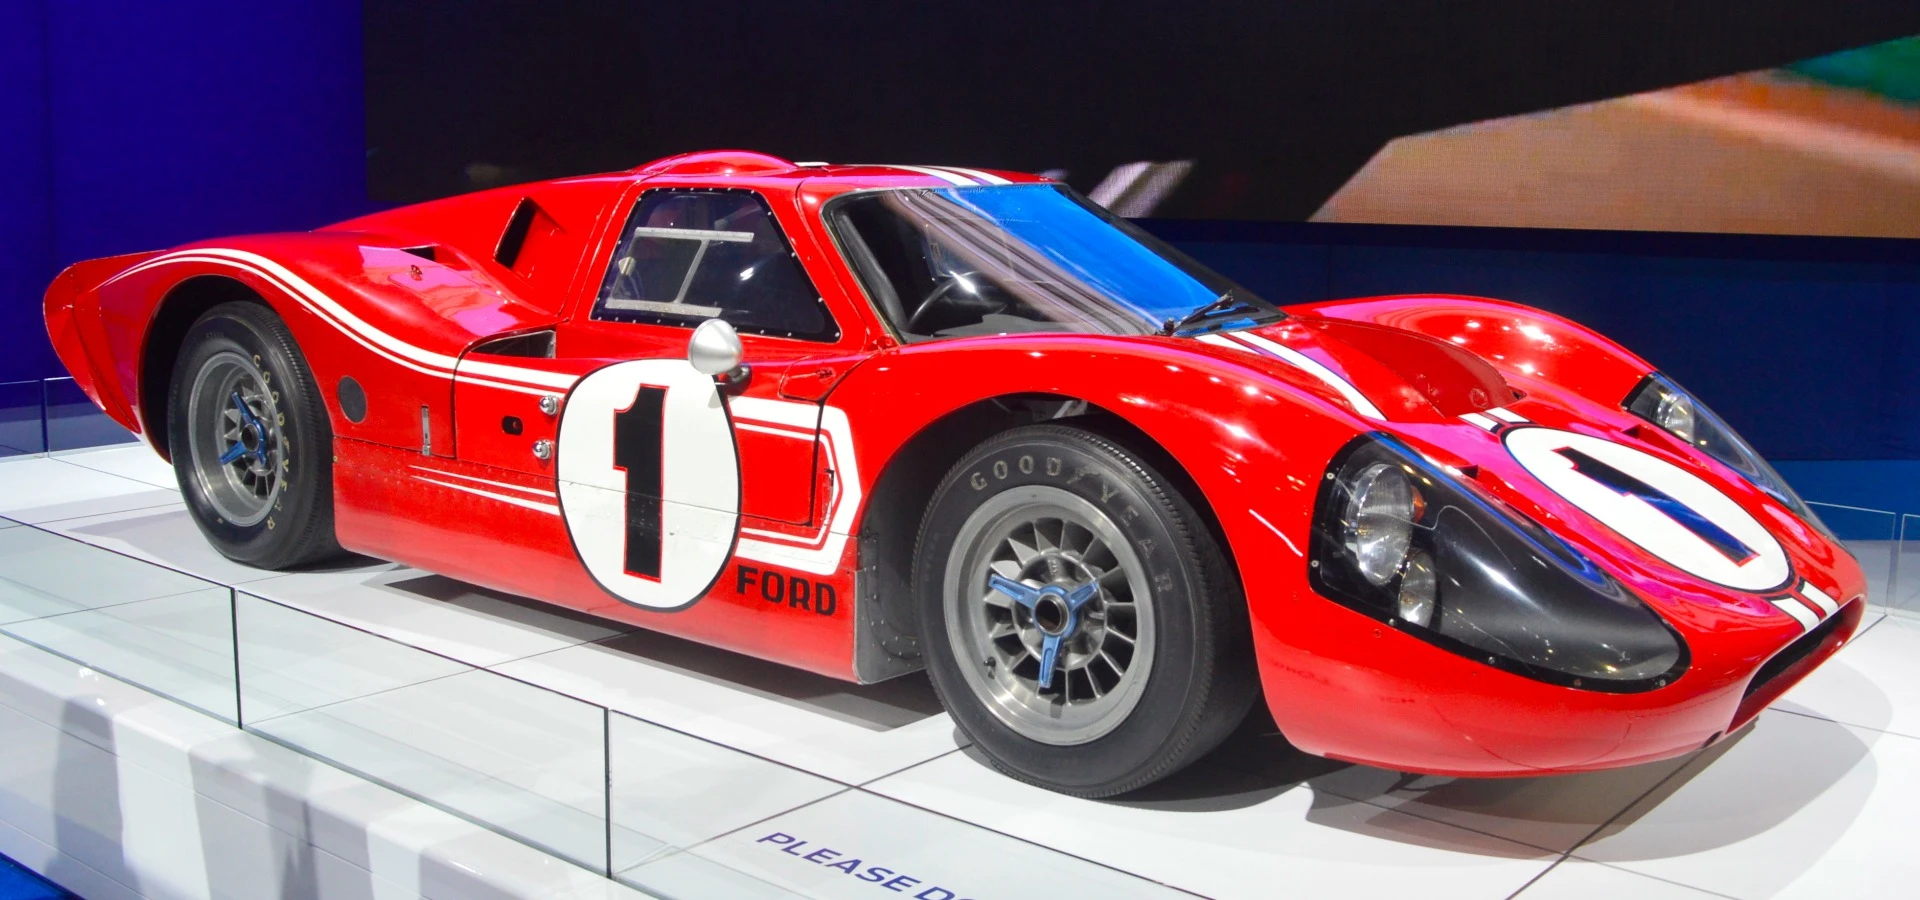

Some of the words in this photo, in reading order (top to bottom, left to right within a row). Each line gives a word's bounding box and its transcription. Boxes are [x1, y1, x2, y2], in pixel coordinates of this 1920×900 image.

[612, 383, 670, 584] 1
[970, 455, 1173, 593] GOODYEAR
[1550, 446, 1761, 567] 1
[736, 564, 837, 616] FORD
[755, 832, 922, 892] PLEASE
[914, 886, 977, 900] D
